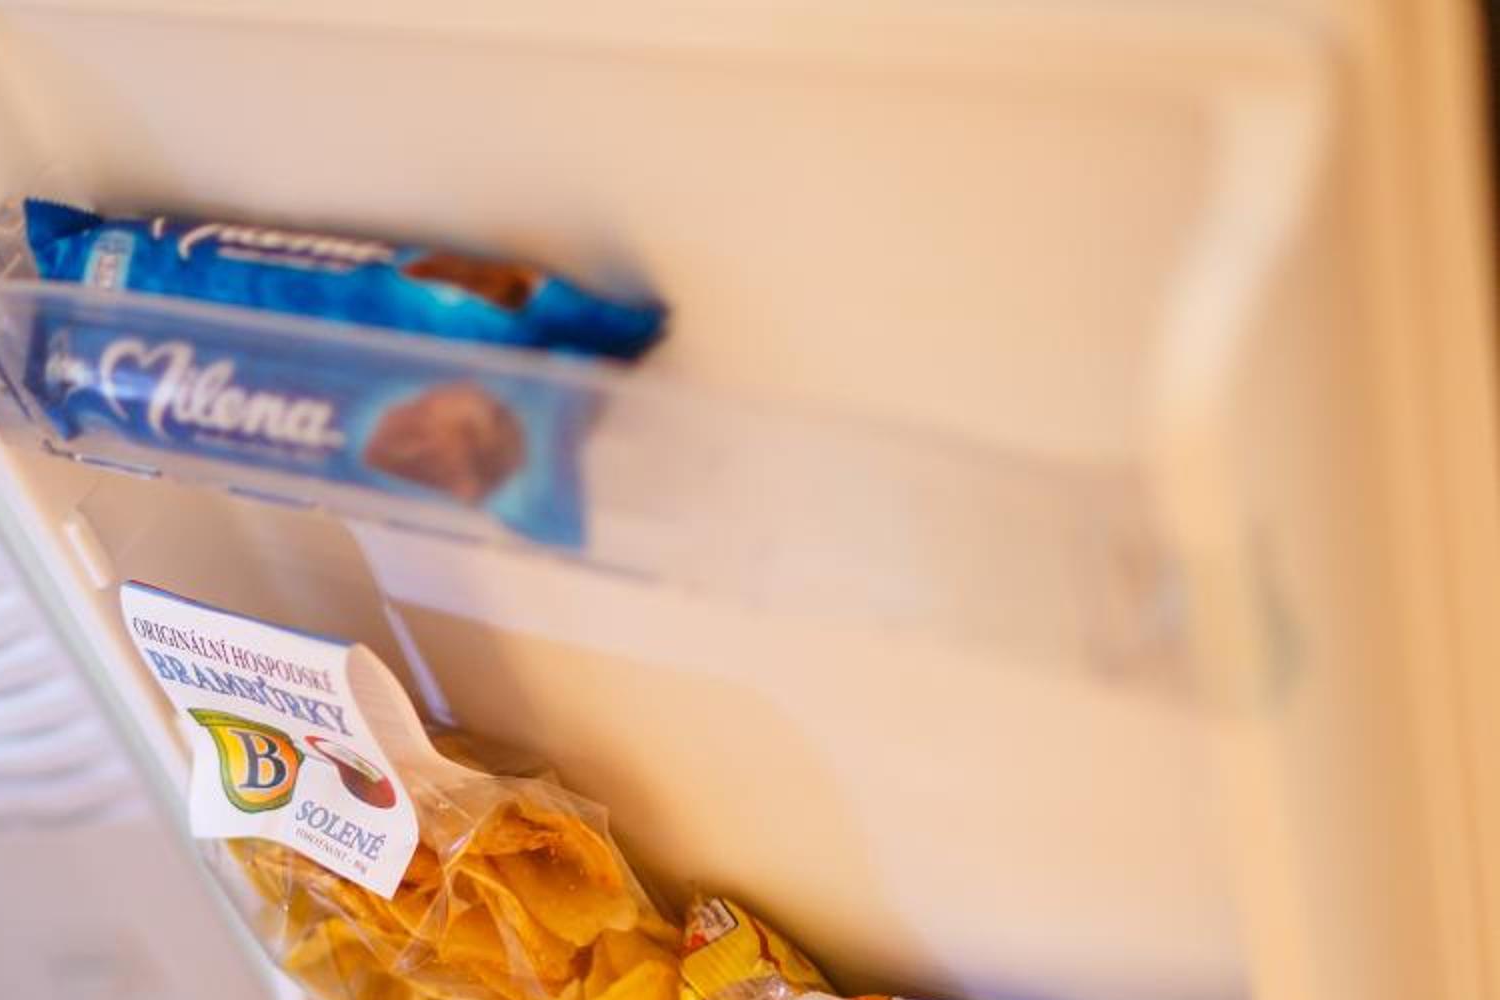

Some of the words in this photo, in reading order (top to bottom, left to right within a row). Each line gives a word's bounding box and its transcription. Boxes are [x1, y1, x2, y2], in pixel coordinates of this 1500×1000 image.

[102, 338, 345, 448] Milena
[231, 730, 287, 789] B
[295, 799, 387, 861] SOLENÉ
